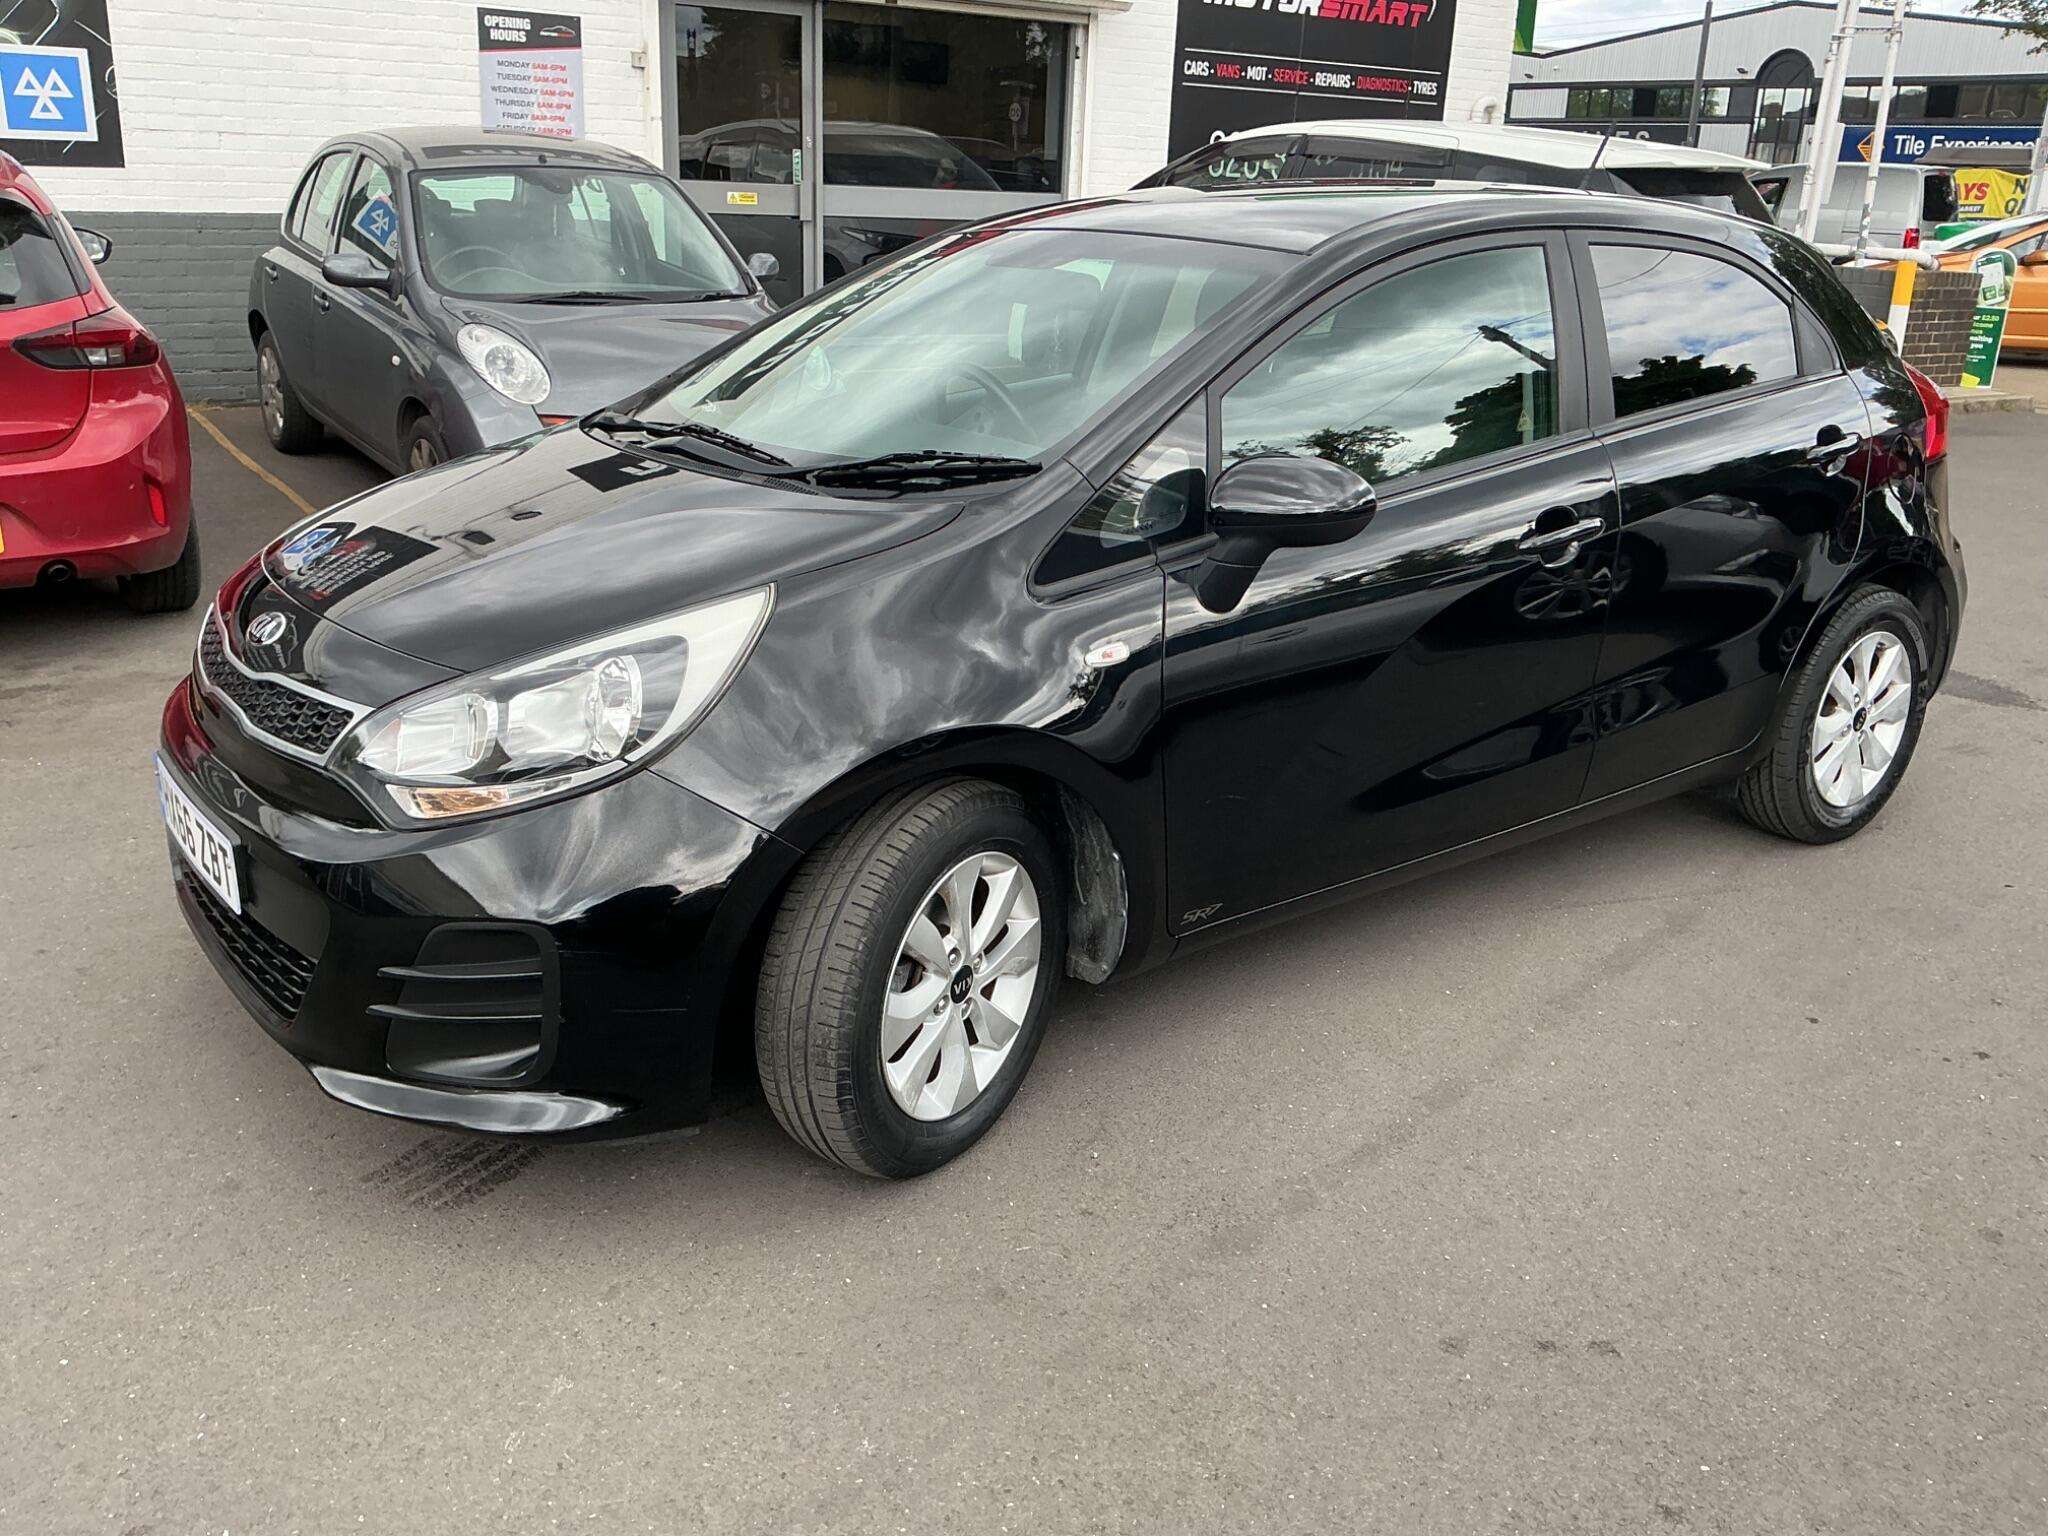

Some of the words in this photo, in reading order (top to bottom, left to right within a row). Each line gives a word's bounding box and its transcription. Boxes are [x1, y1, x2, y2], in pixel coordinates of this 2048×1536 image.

[1203, 0, 1430, 28] ORSMART
[484, 15, 531, 30] OPENING
[490, 28, 527, 42] HOURS
[497, 60, 530, 69] MONDAY
[497, 73, 531, 81] TUESDAY
[1184, 60, 1210, 76] CARS
[1216, 63, 1240, 79] VANS
[1246, 65, 1267, 81] MOT
[1273, 68, 1308, 85] SERVICE
[1315, 71, 1350, 89] REPAIRS
[1356, 75, 1408, 93] DIAGNOSTICS
[1413, 80, 1438, 96] TYRES
[490, 85, 538, 95] WEDNESDAY
[495, 98, 535, 108] THURSDAY
[502, 112, 529, 120] FRIDAY
[1894, 135, 1925, 155] Tile
[195, 816, 231, 898] ZBT
